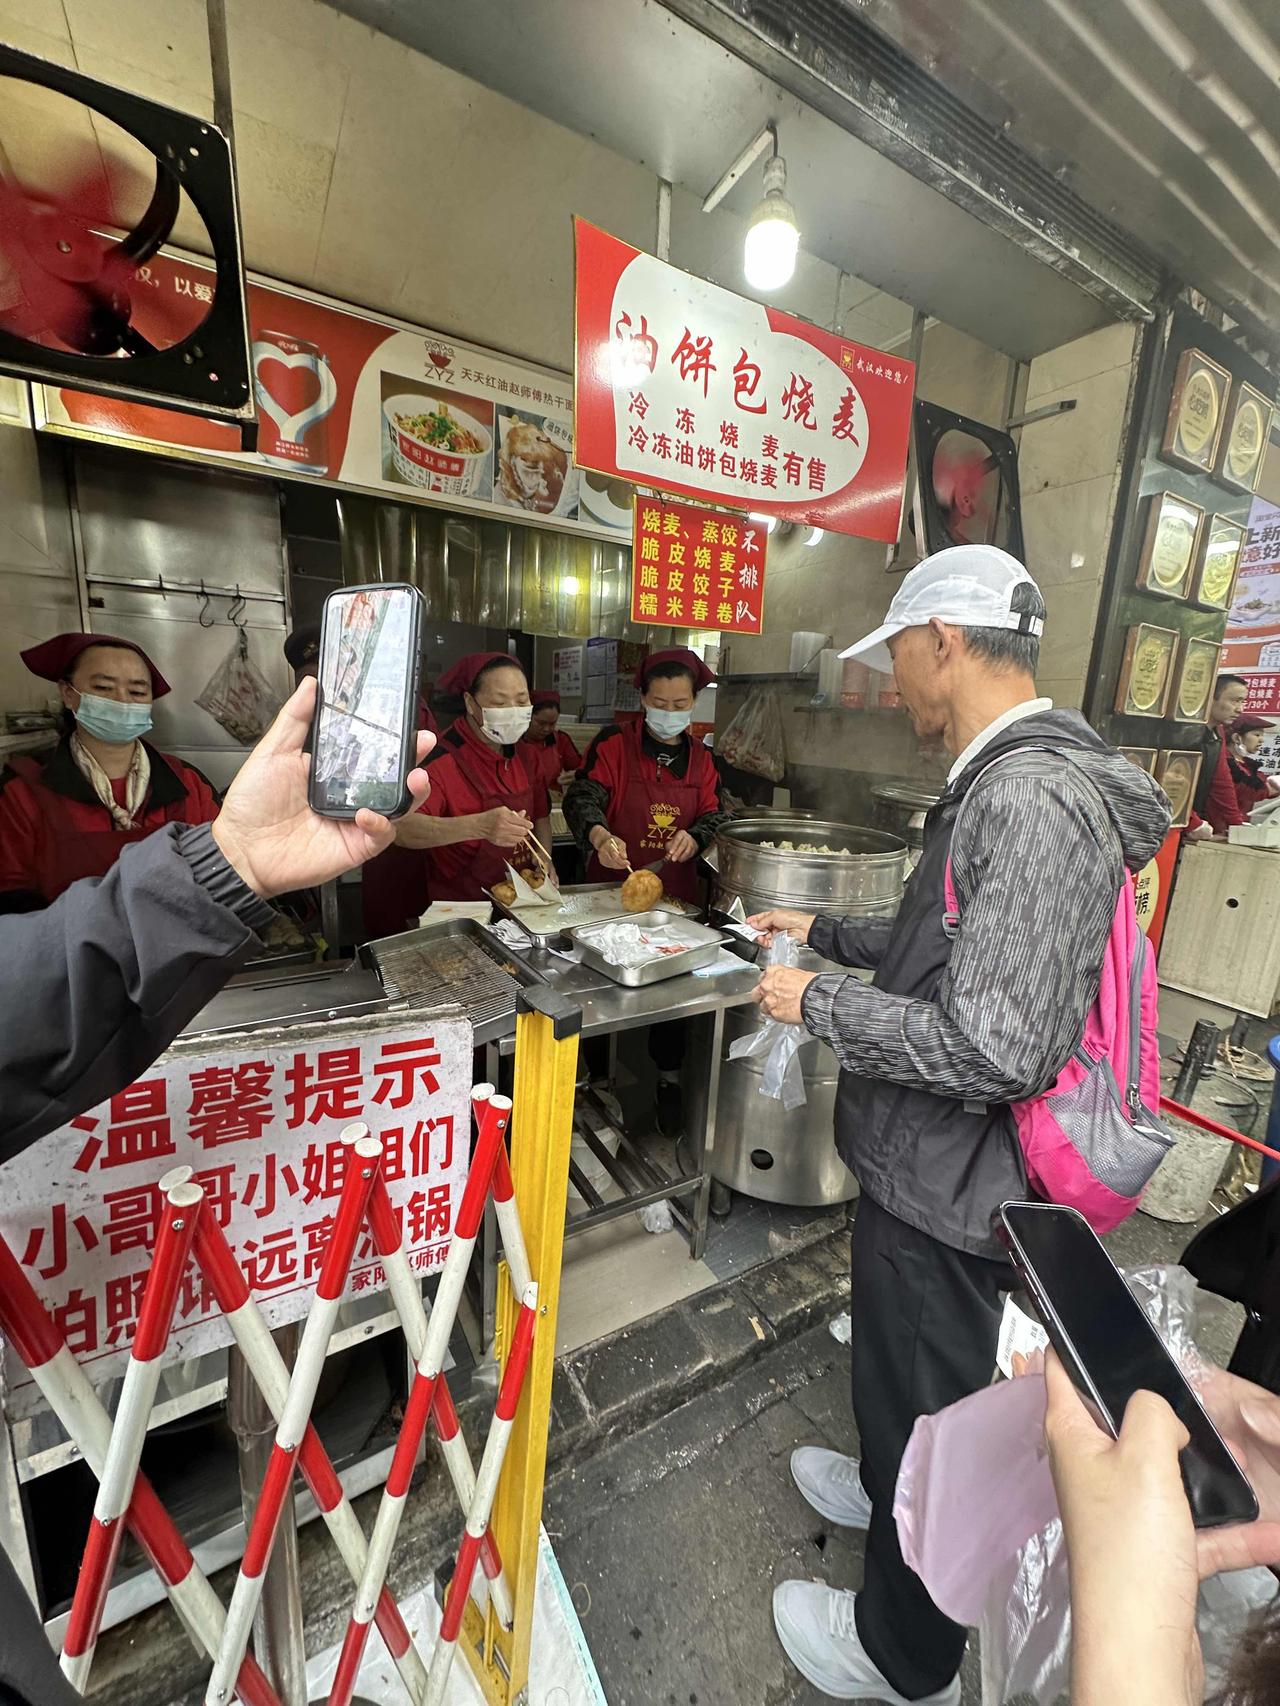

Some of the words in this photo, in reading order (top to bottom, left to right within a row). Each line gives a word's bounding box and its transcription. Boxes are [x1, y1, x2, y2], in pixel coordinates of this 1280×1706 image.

[461, 367, 573, 412] 天天红油赵师傅热干面
[616, 310, 860, 447] 油饼包烧麦
[641, 537, 736, 573] 脆皮烧麦
[640, 565, 735, 598] 脆皮饺子
[639, 592, 733, 624] 糯米春卷
[70, 1037, 441, 1173] 温馨提示
